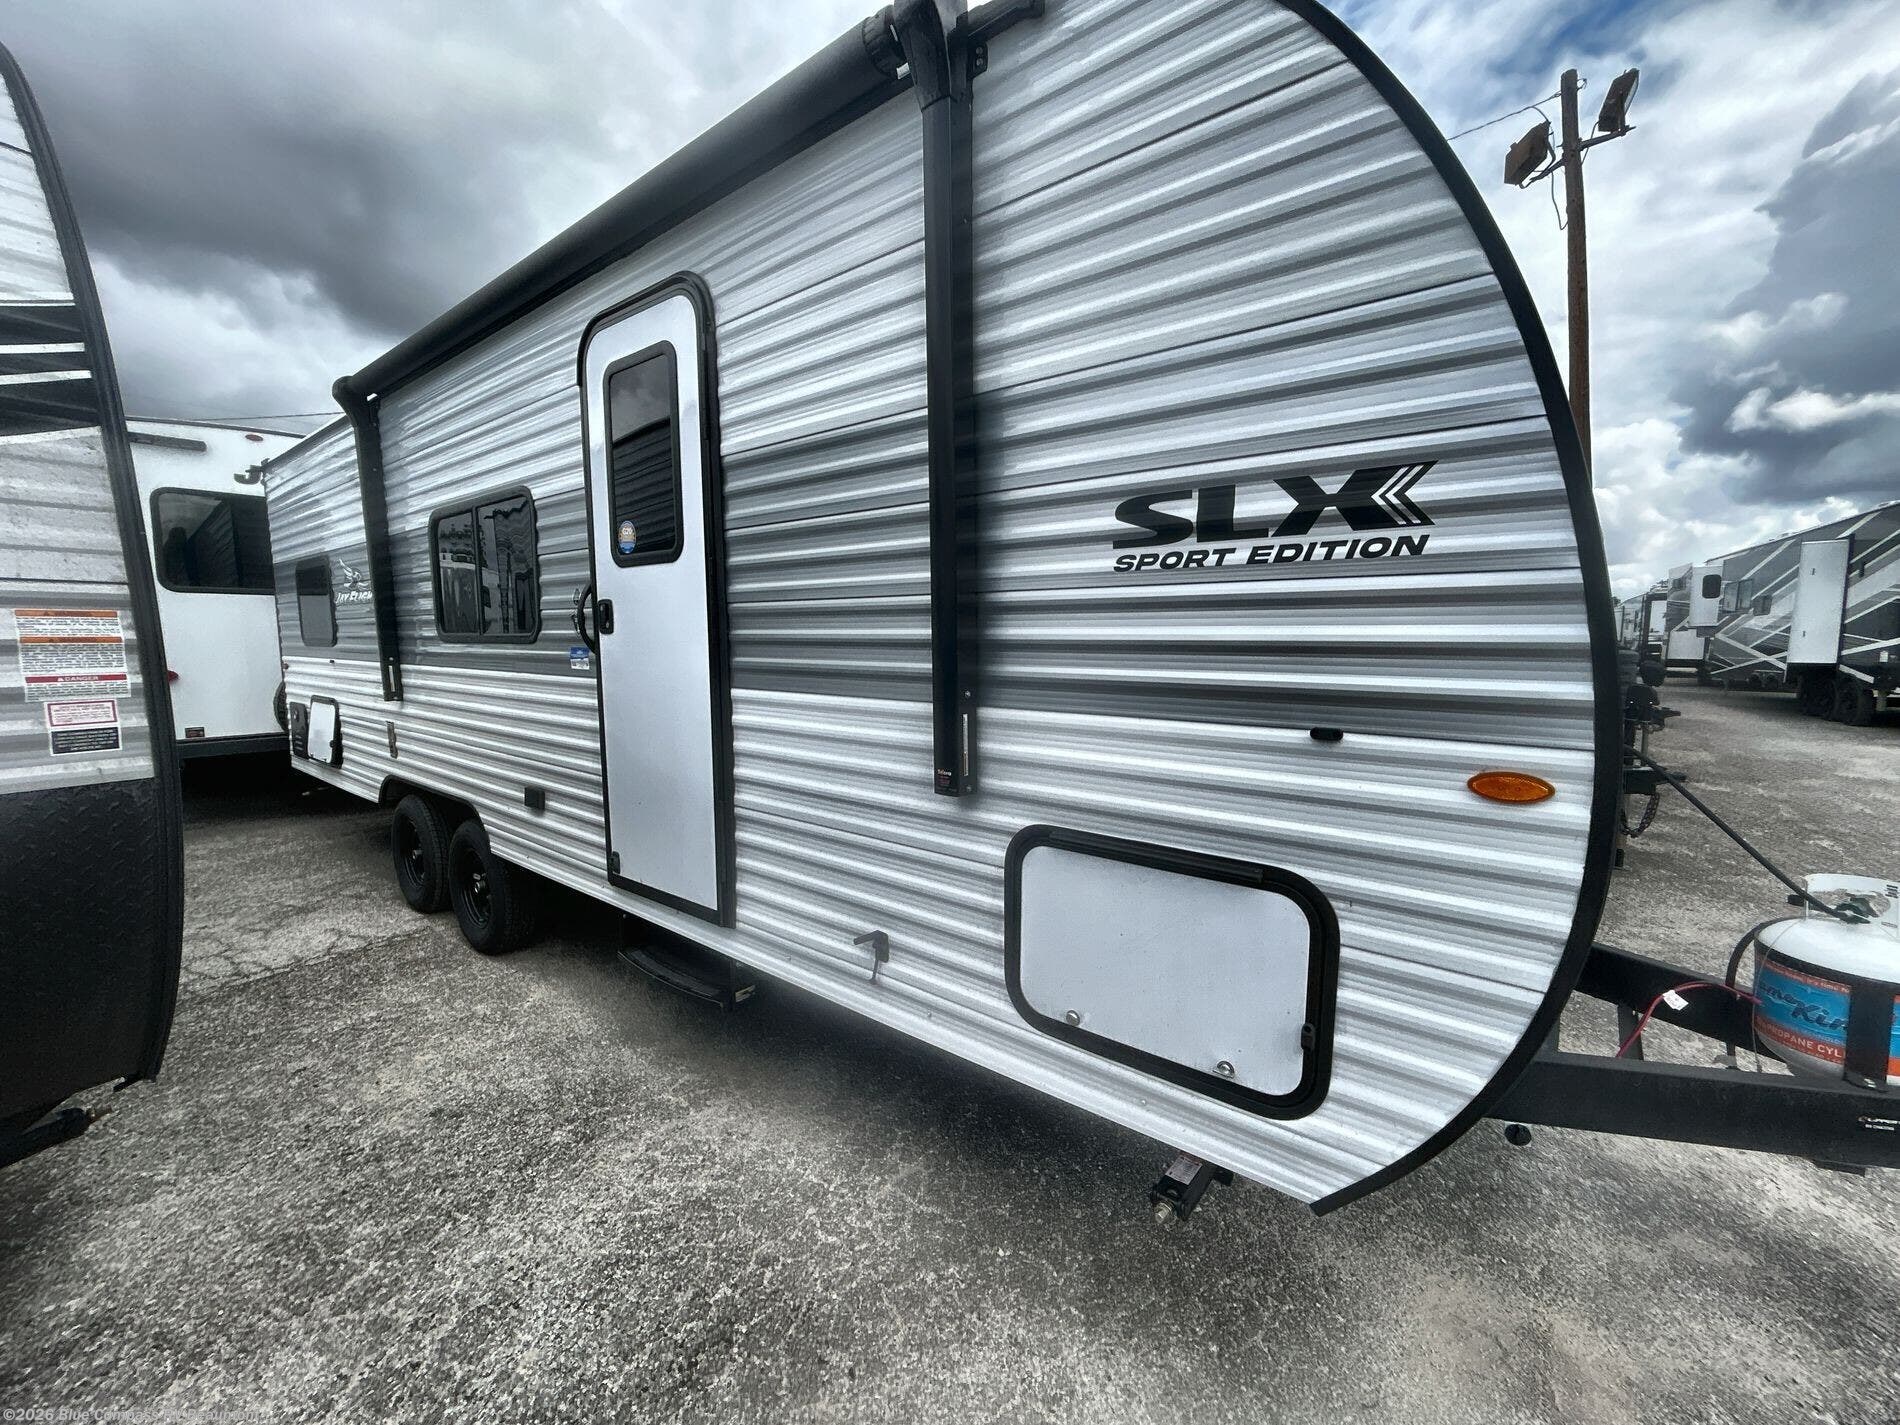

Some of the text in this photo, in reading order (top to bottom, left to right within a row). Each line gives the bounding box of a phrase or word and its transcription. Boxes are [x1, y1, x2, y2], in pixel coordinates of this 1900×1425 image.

[1112, 460, 1439, 549] SLX
[1113, 534, 1431, 573] SPORT EDITION
[1817, 1043, 1846, 1059] CYL
